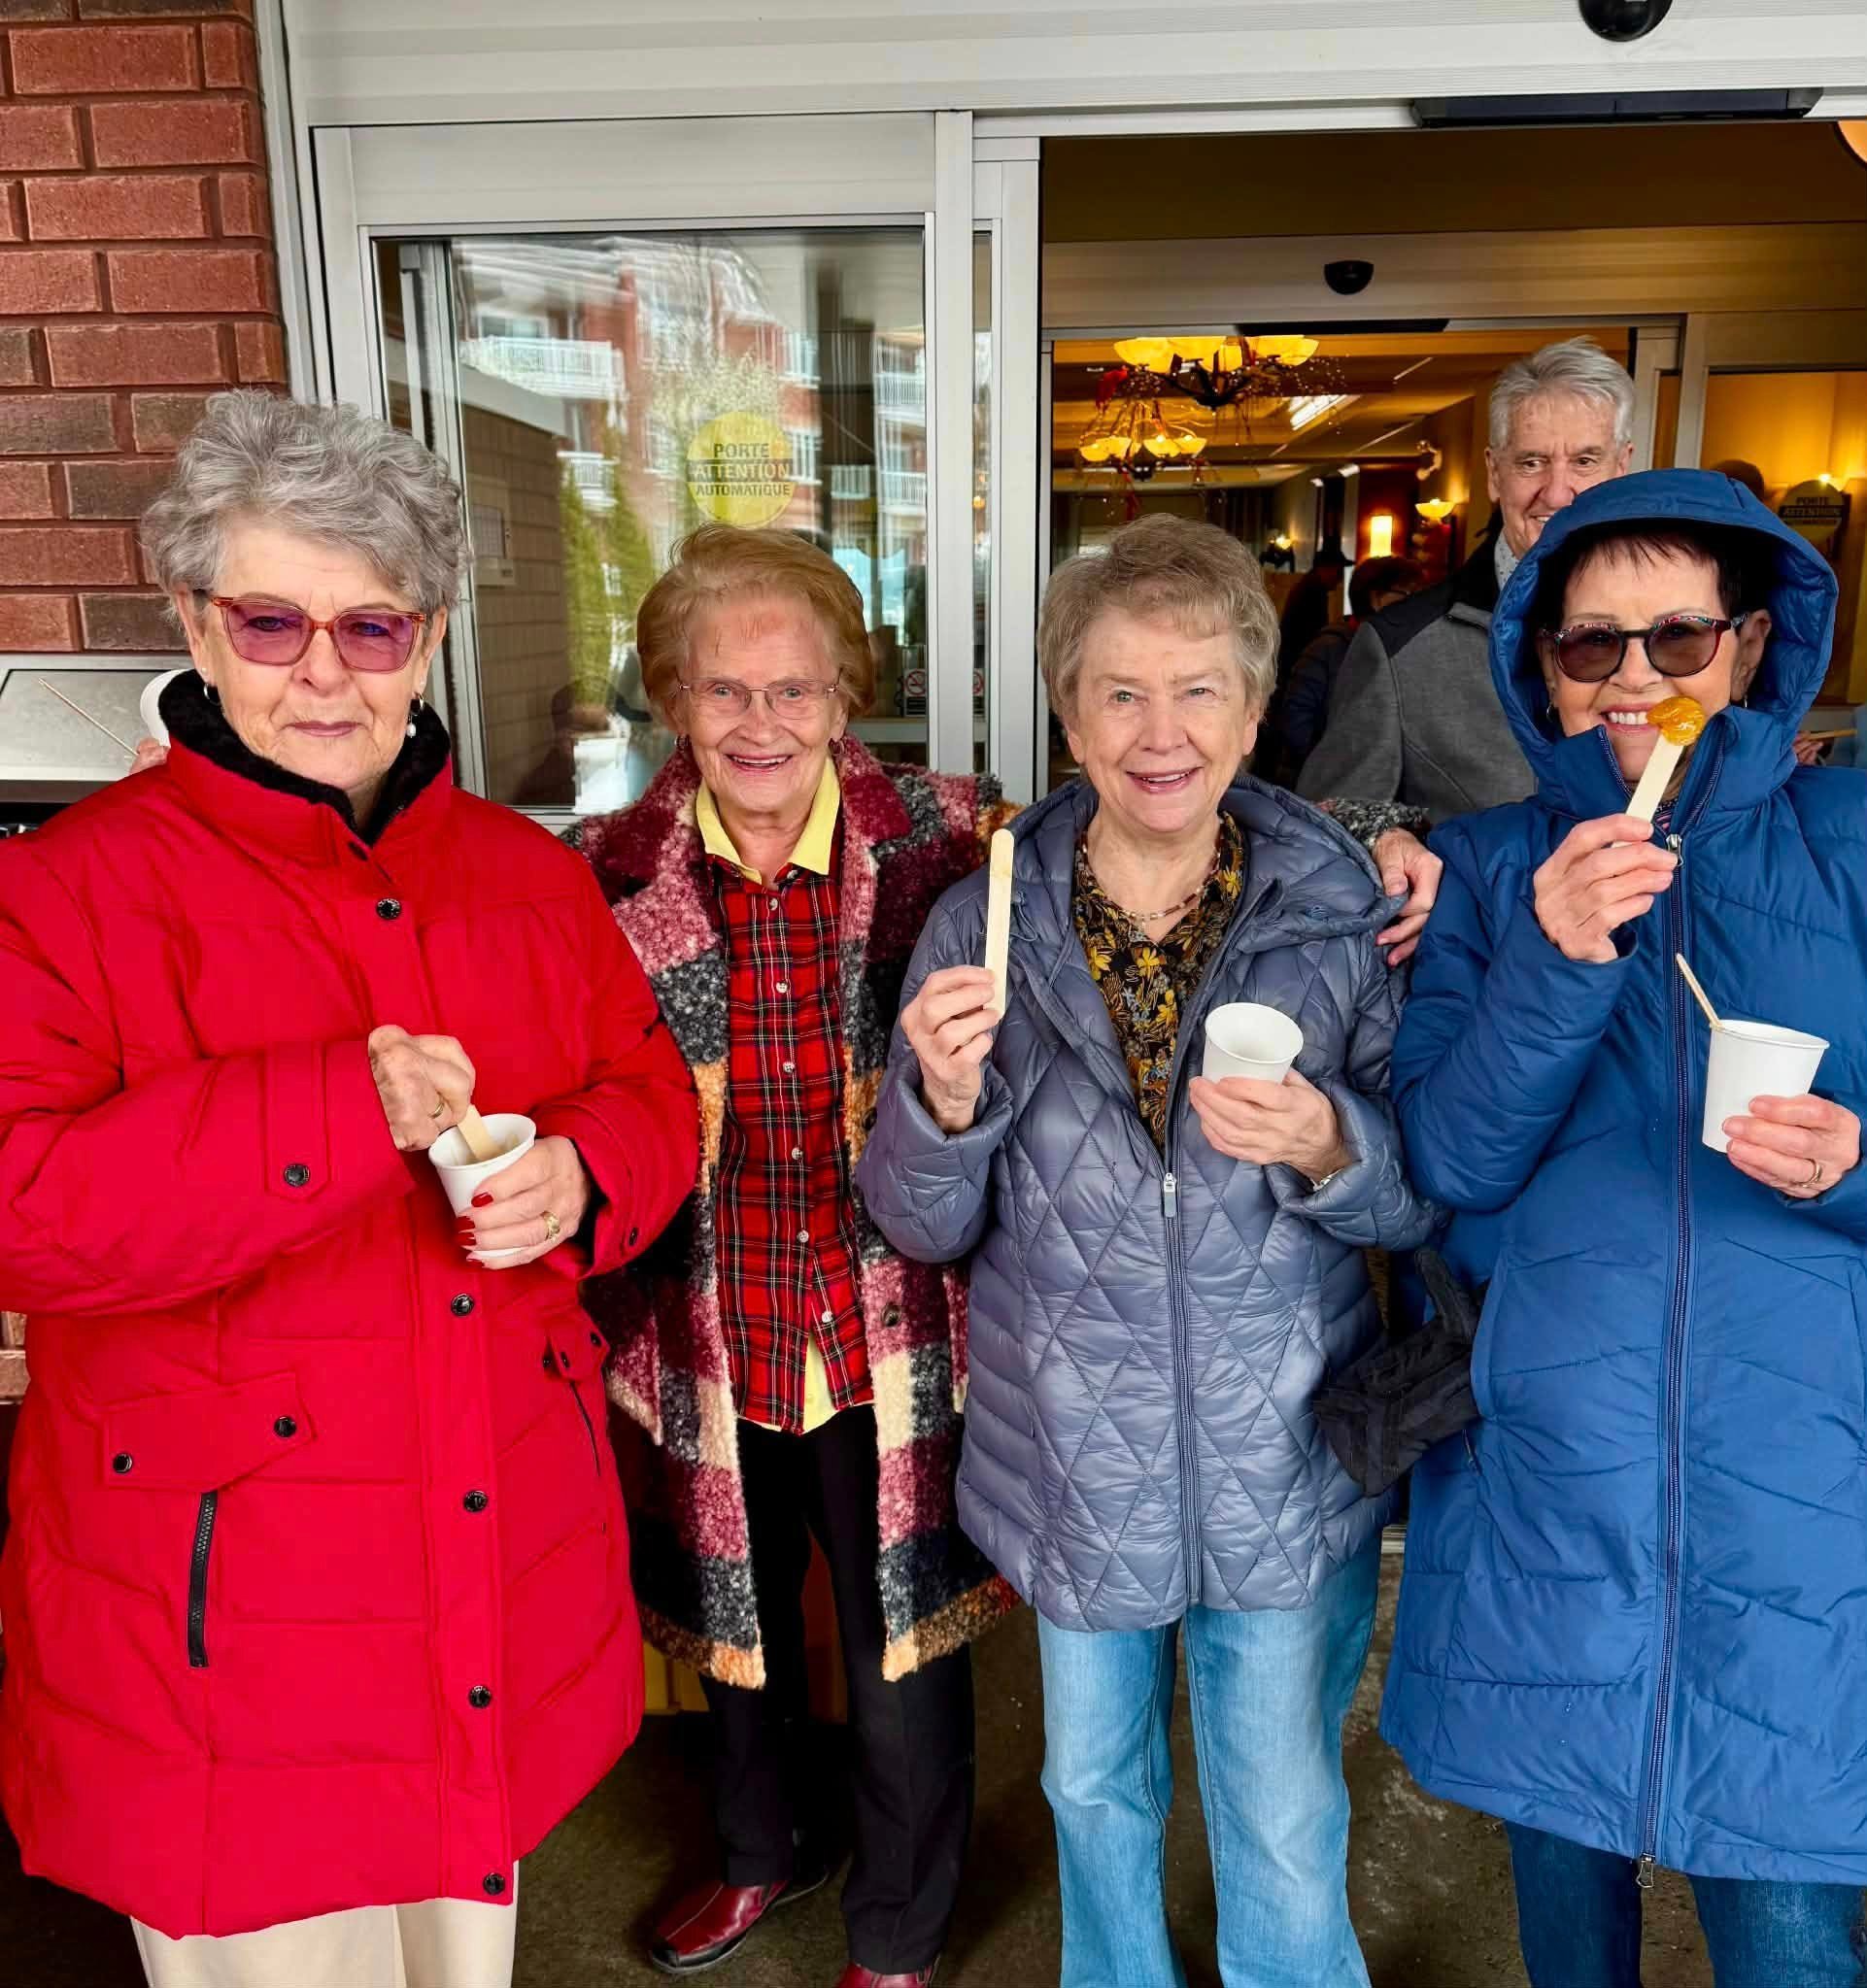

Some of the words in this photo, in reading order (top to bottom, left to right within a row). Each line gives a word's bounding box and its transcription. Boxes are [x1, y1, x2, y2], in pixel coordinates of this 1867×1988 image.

[714, 443, 769, 457] PORTE
[695, 463, 790, 479] ATTENTION
[696, 484, 791, 496] AUTOMATIQUE
